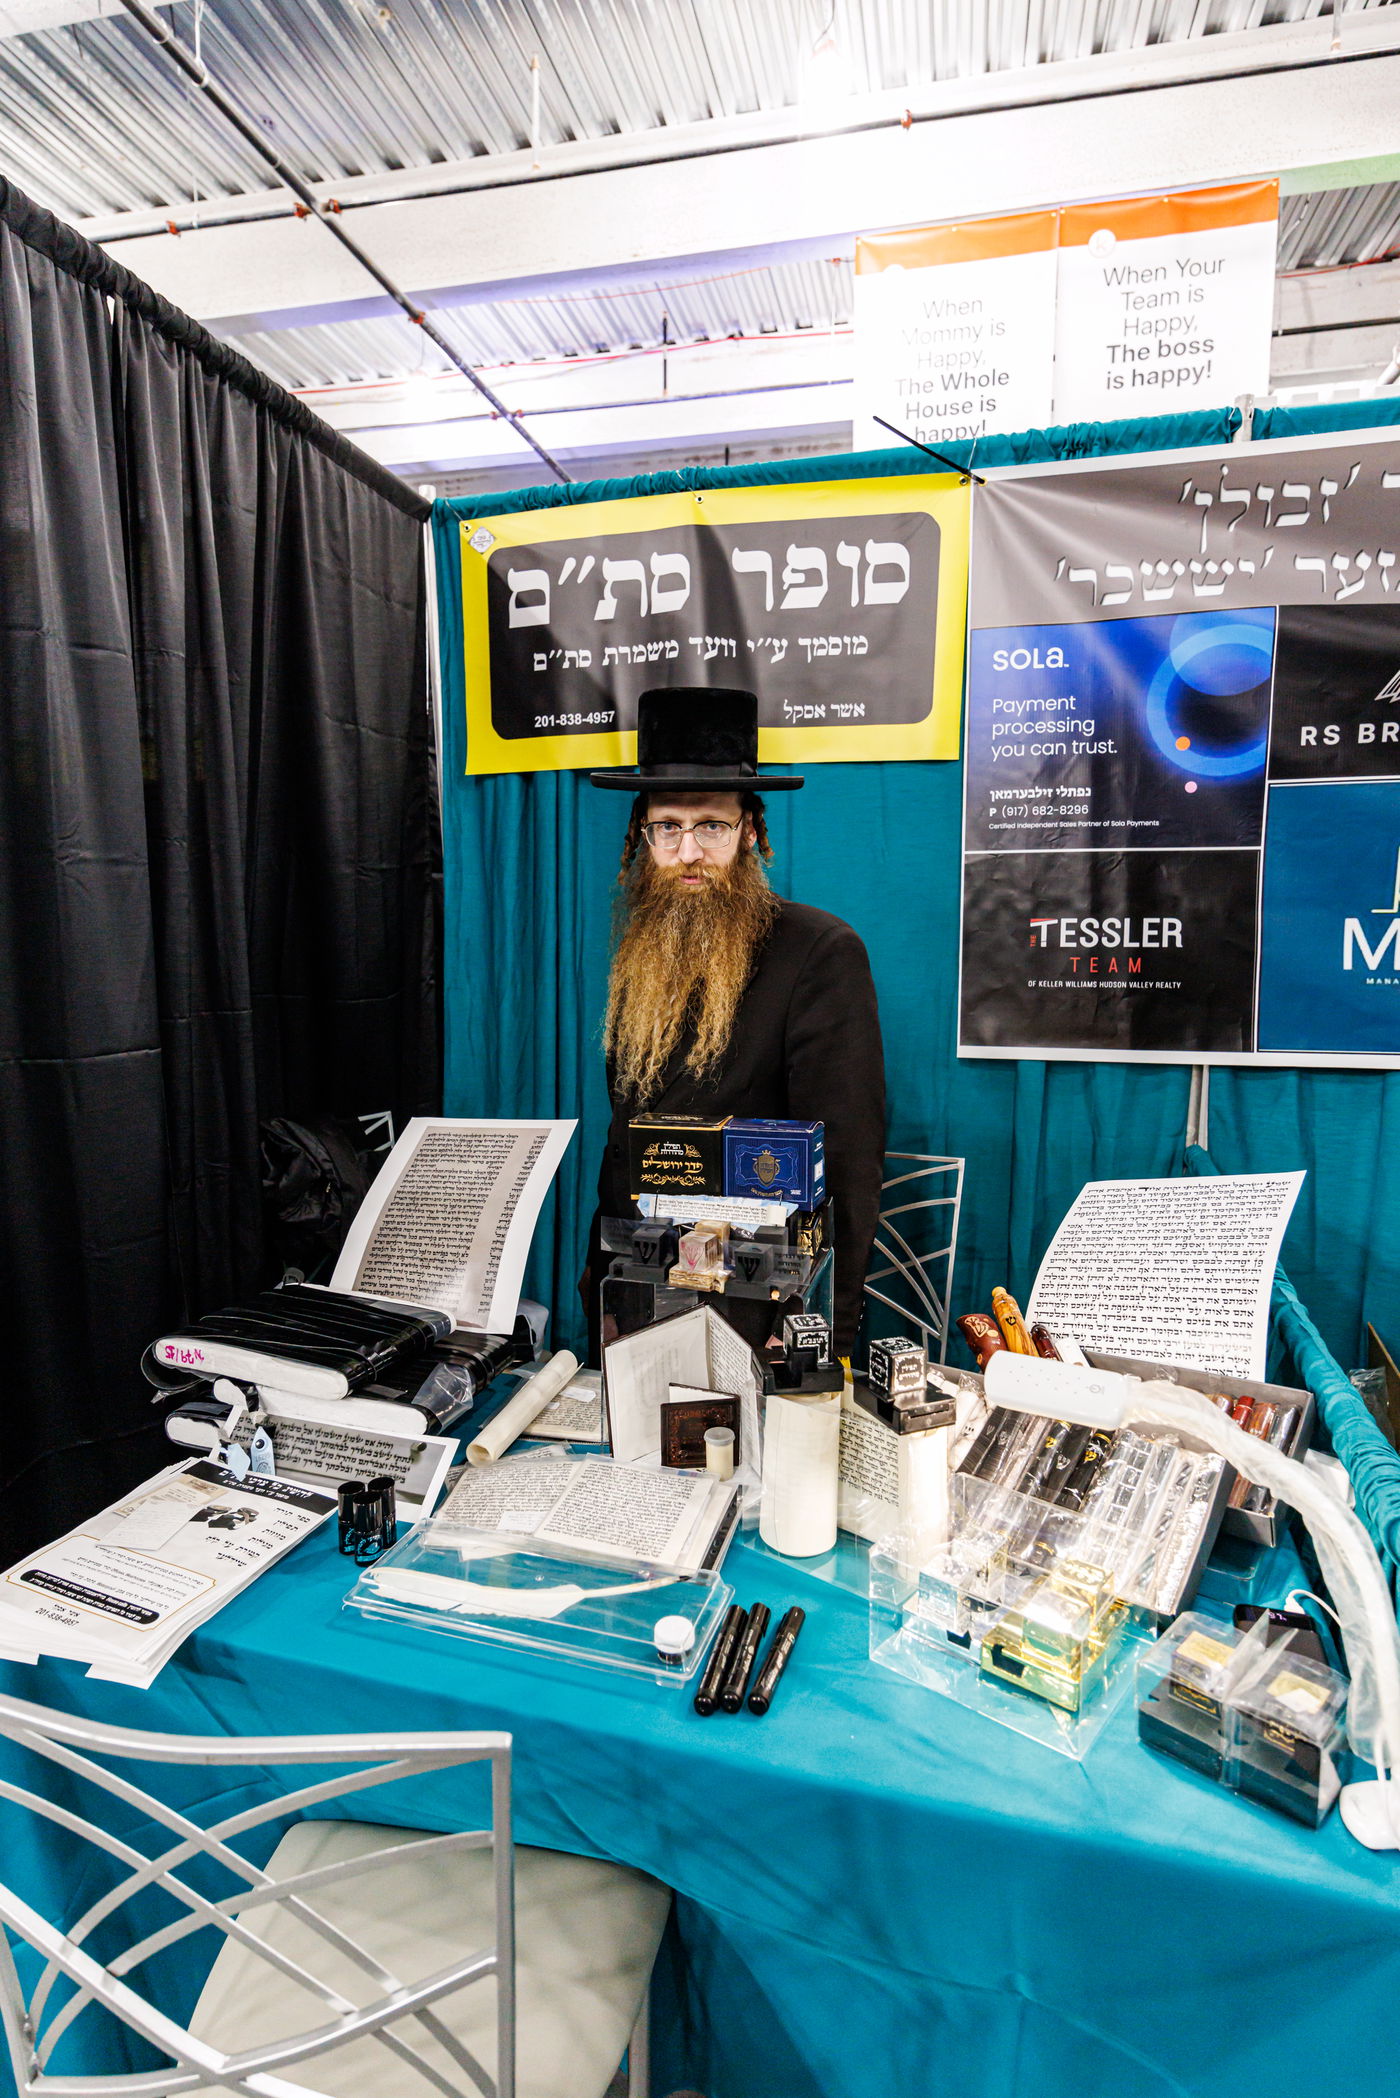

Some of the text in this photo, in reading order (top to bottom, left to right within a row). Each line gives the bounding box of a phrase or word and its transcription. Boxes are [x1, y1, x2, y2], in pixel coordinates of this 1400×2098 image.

[1103, 257, 1226, 287] When Your
[923, 299, 983, 319] When
[1120, 283, 1205, 311] Team is
[902, 318, 1006, 345] Mommy is
[1123, 314, 1198, 339] Happy,
[917, 349, 986, 371] Happy,
[1106, 338, 1215, 364] The boss
[895, 368, 1010, 396] The Whole
[1106, 359, 1212, 390] is happy!
[905, 394, 996, 420] House is
[915, 419, 986, 443] happy!
[731, 538, 911, 612] סופר
[602, 638, 680, 666] משמרת
[688, 635, 737, 661] וועד
[798, 635, 869, 664] מוסמך
[783, 699, 866, 724] אשר אסקל
[992, 695, 1076, 717] Payment
[534, 710, 615, 729] 201-838-4957
[992, 717, 1095, 740] processing
[1300, 724, 1341, 747] RS
[991, 739, 1118, 762] you can trust.
[989, 785, 1092, 802] נפתלי זילבערמאן
[989, 804, 1089, 818] P (917) 682-8296
[988, 822, 1016, 830] Certified
[1016, 821, 1058, 830] Independent
[1078, 820, 1102, 828] Partner
[1102, 820, 1110, 828] of
[1126, 819, 1160, 829] Payments
[1030, 917, 1183, 948] TESSLER
[1069, 957, 1142, 974] TEAM
[1027, 980, 1182, 989] OF KELLER WILLIAMS HUDSON VALLEY REALTY
